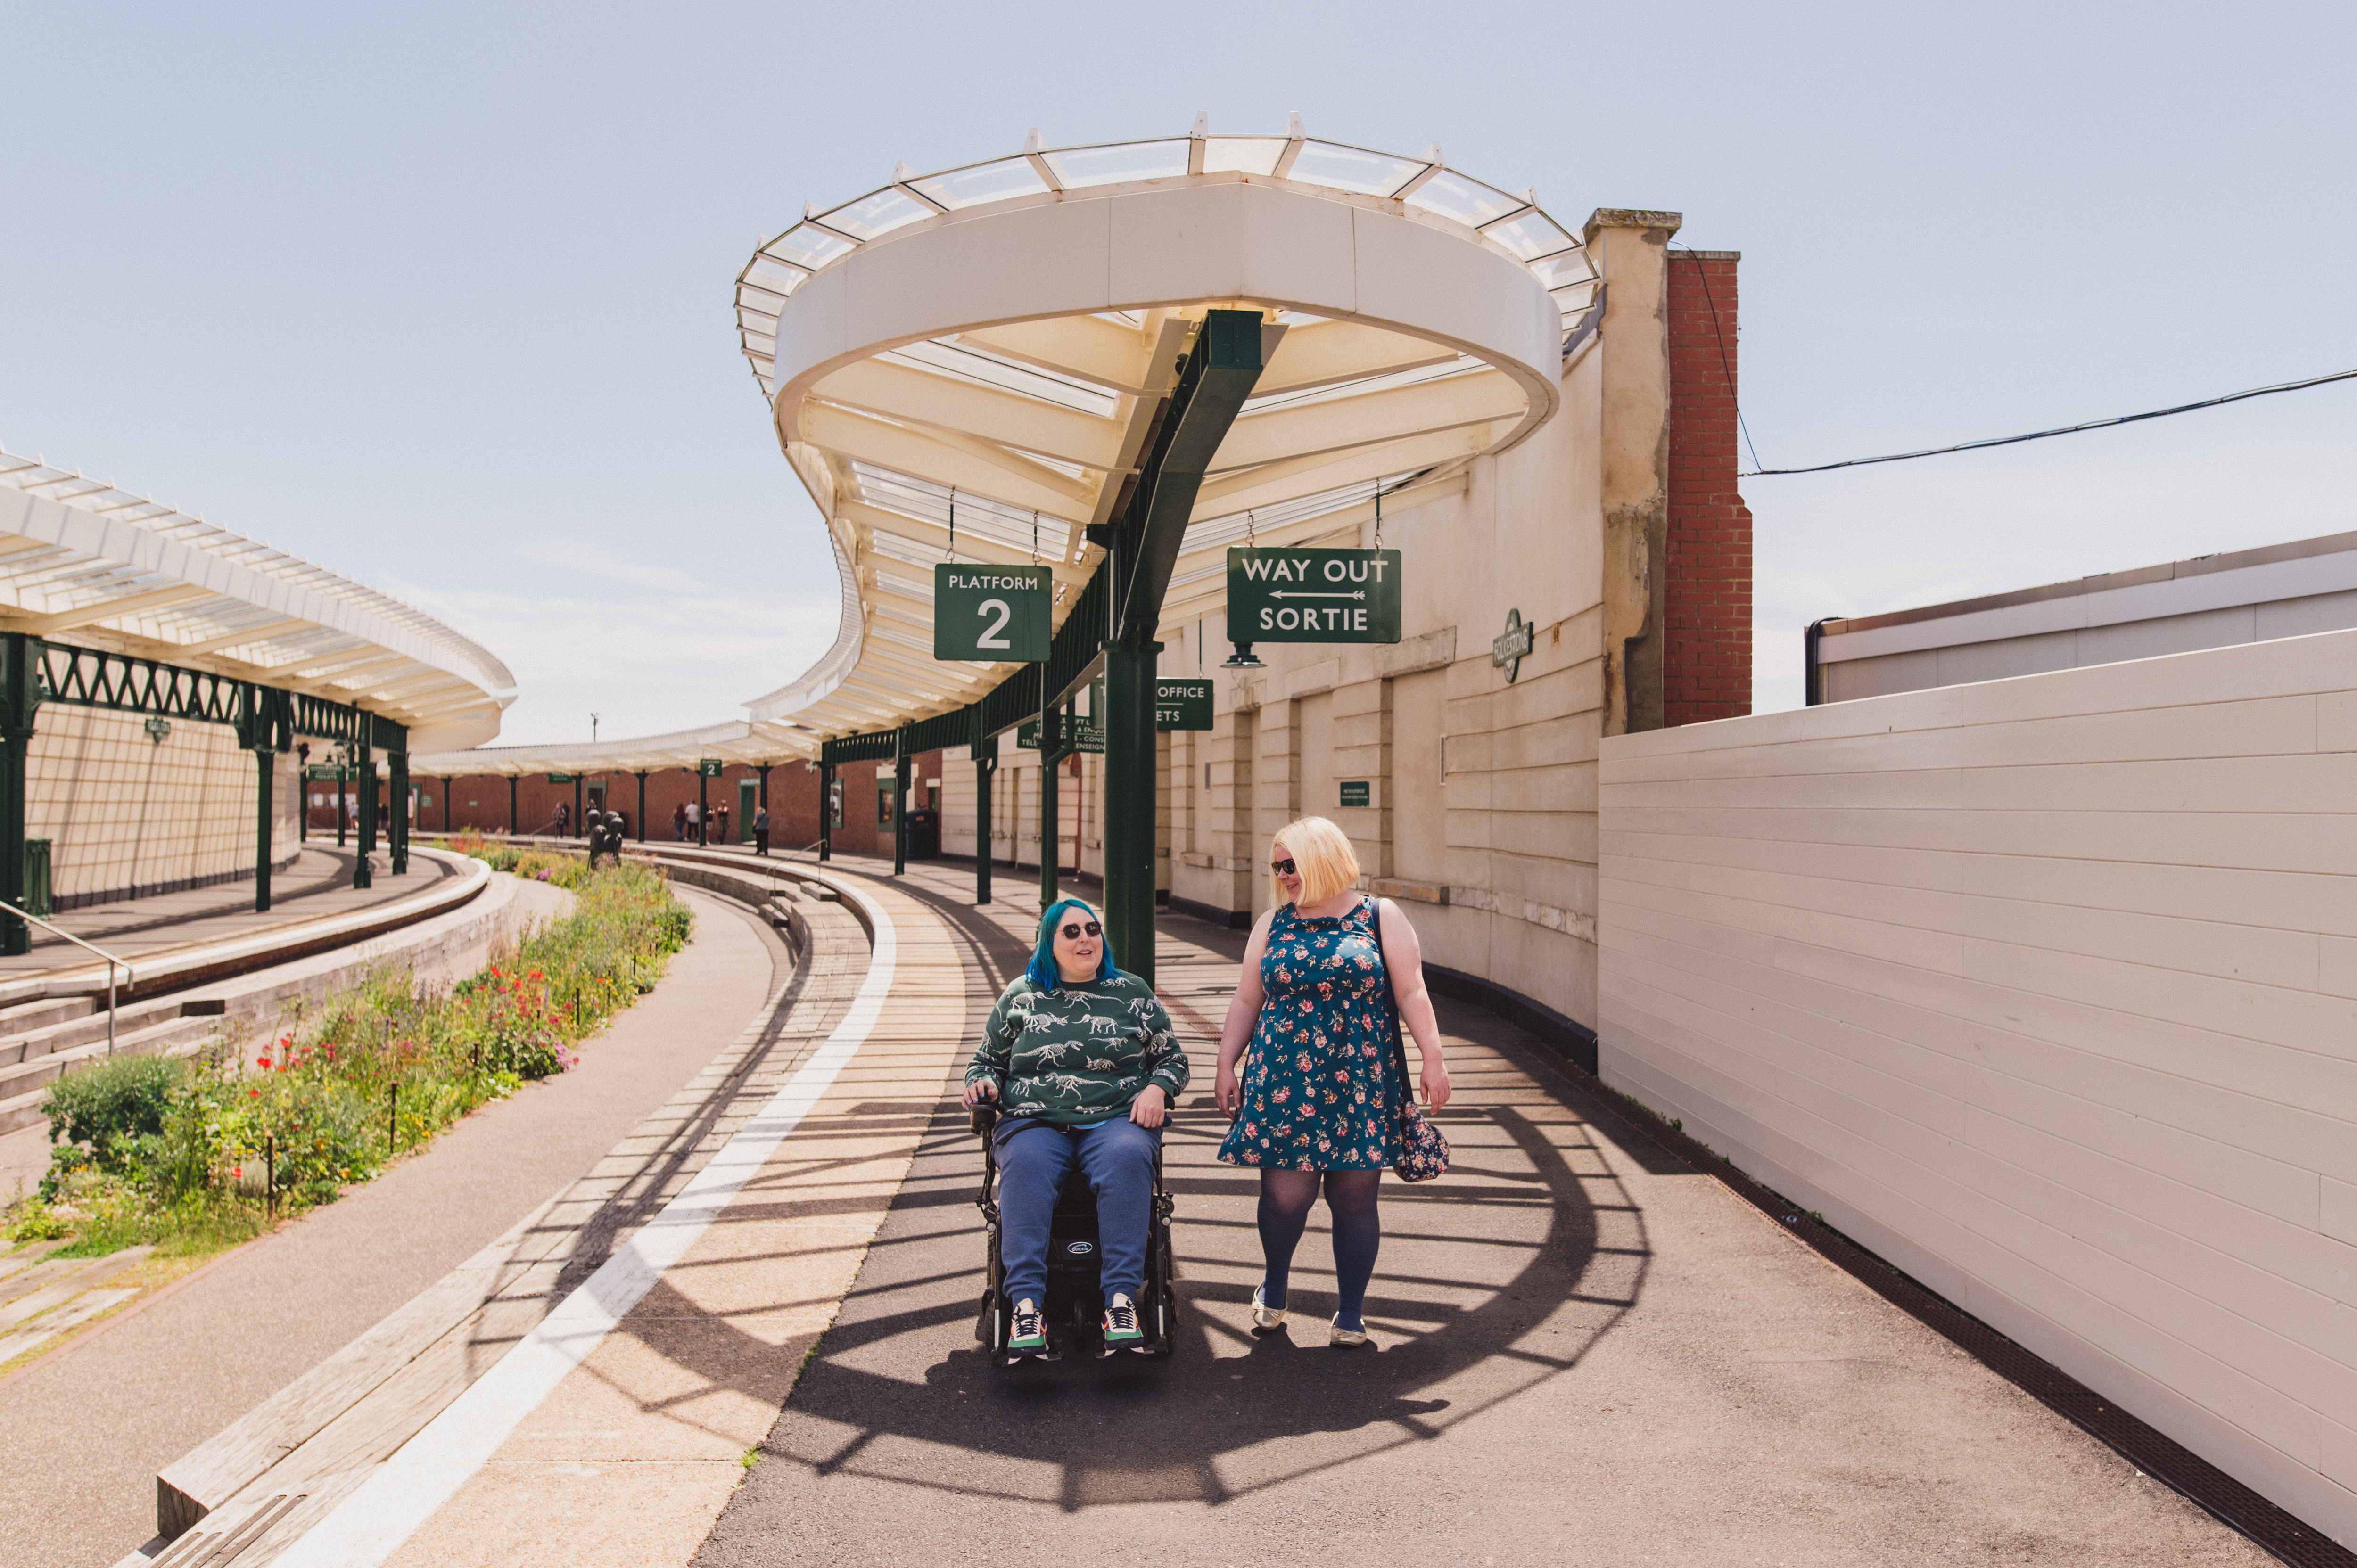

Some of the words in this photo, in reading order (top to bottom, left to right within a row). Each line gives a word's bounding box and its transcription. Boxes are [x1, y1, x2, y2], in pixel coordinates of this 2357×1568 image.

[1242, 559, 1311, 581] WAY
[1324, 559, 1388, 582] OUT
[949, 575, 1038, 590] PLATFORM
[977, 599, 1010, 649] 2
[1260, 608, 1367, 631] SORTIE
[1494, 628, 1527, 662] FOLKESTONE
[1158, 687, 1204, 698] OFFICE
[708, 764, 715, 775] 2
